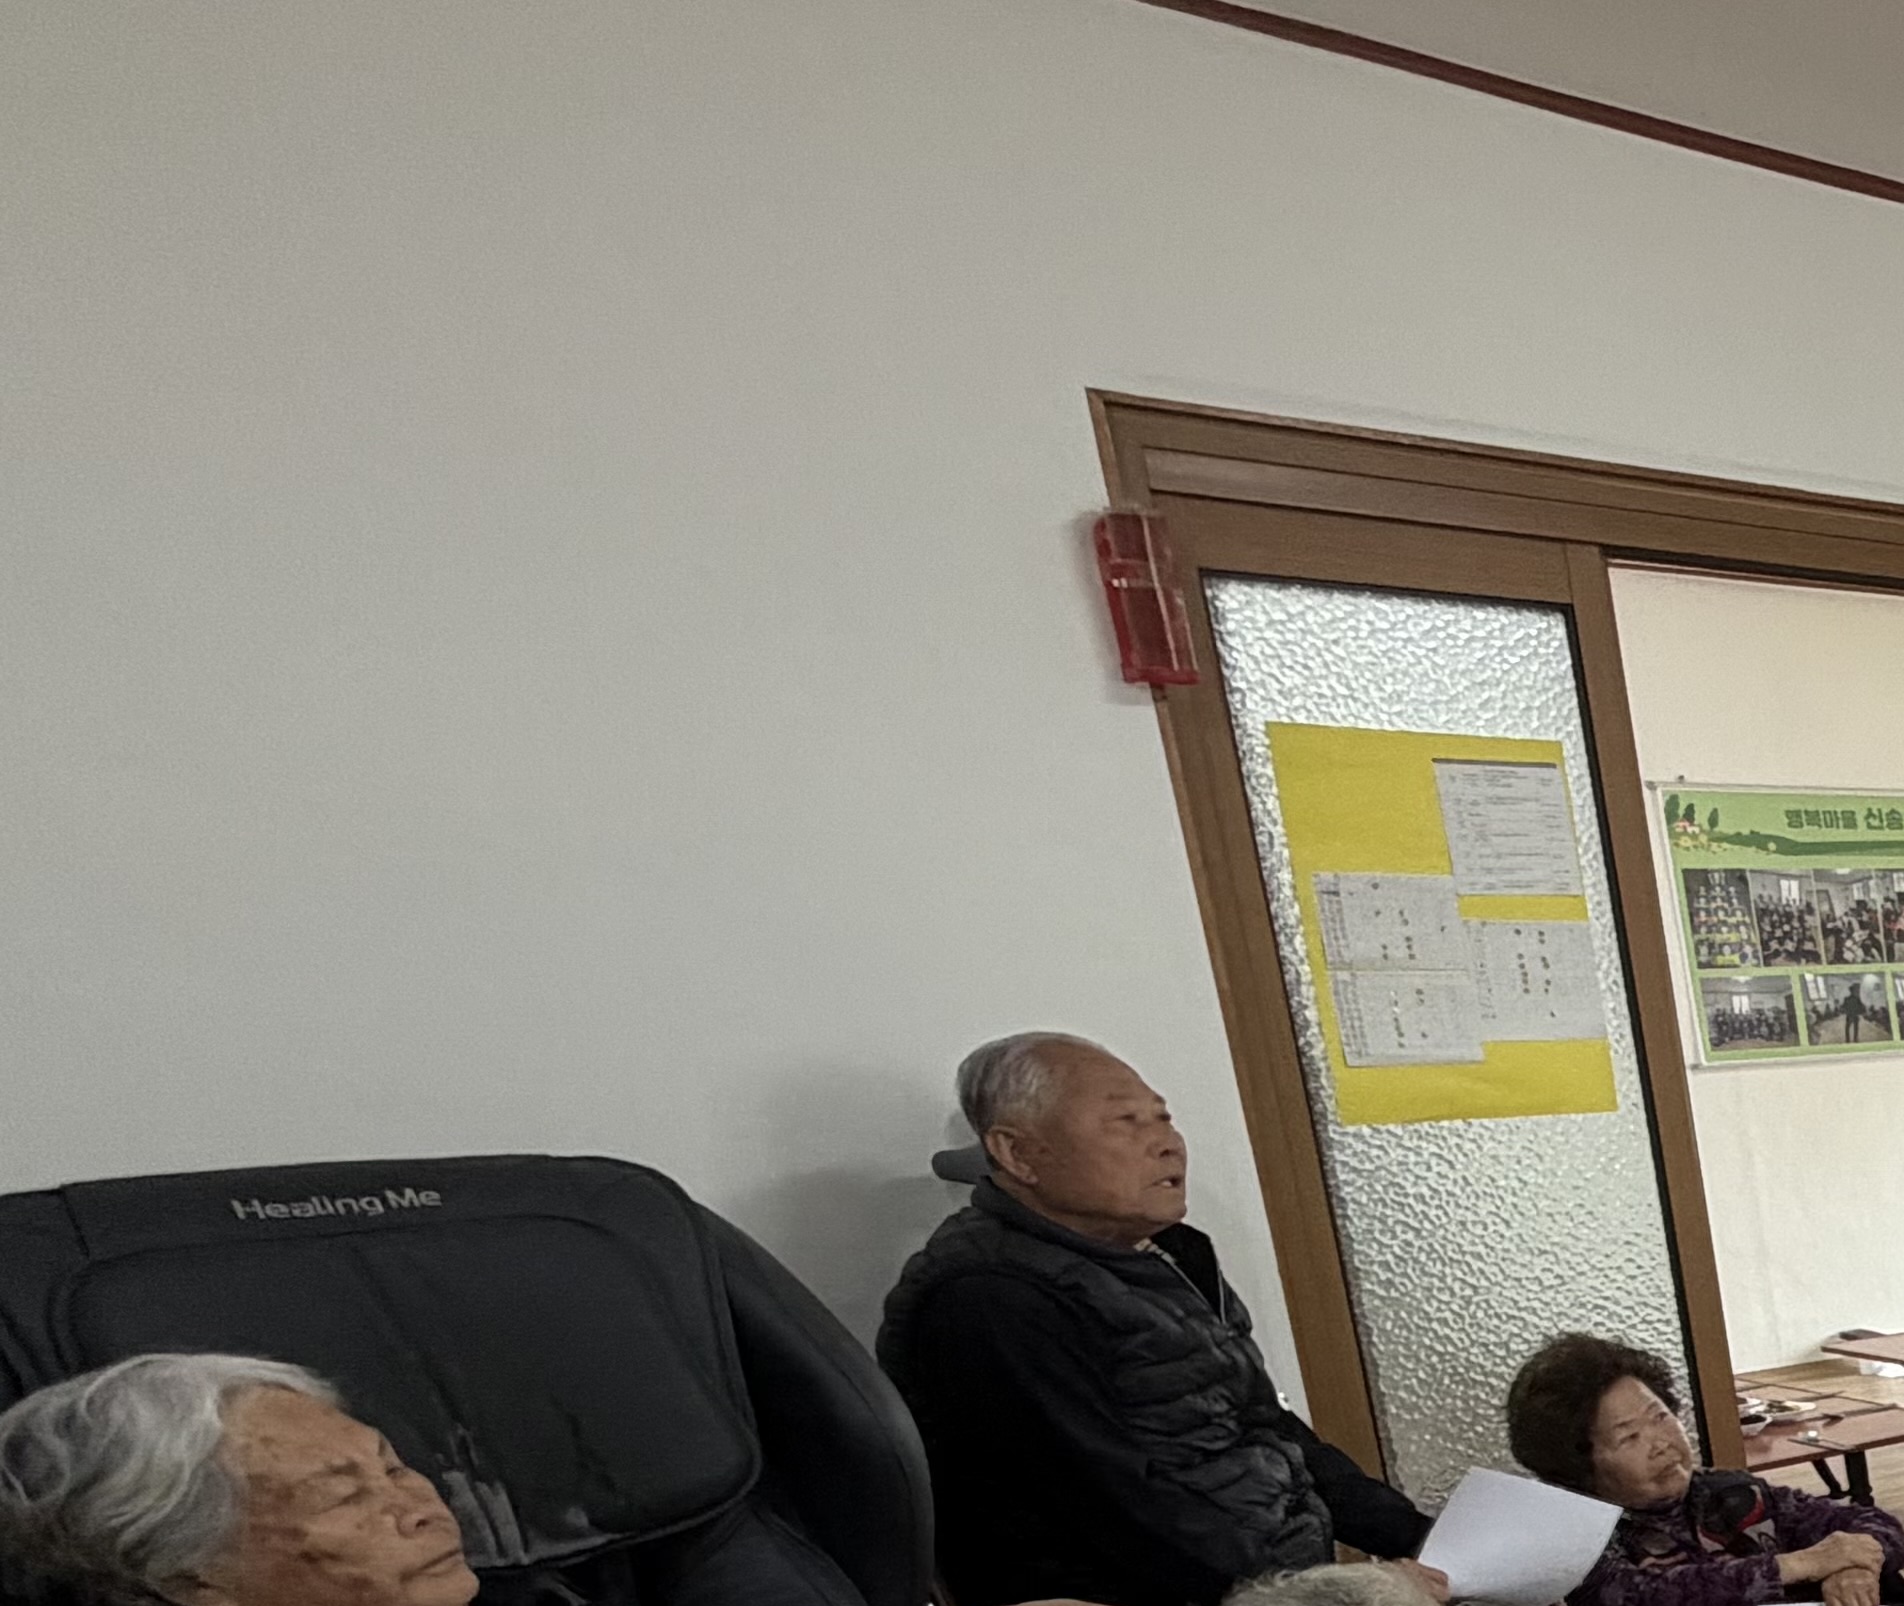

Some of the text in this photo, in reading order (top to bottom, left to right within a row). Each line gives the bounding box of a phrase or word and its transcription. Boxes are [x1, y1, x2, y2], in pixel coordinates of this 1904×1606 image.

[1784, 808, 1858, 830] 행복마을
[230, 1187, 442, 1220] Healing Me
